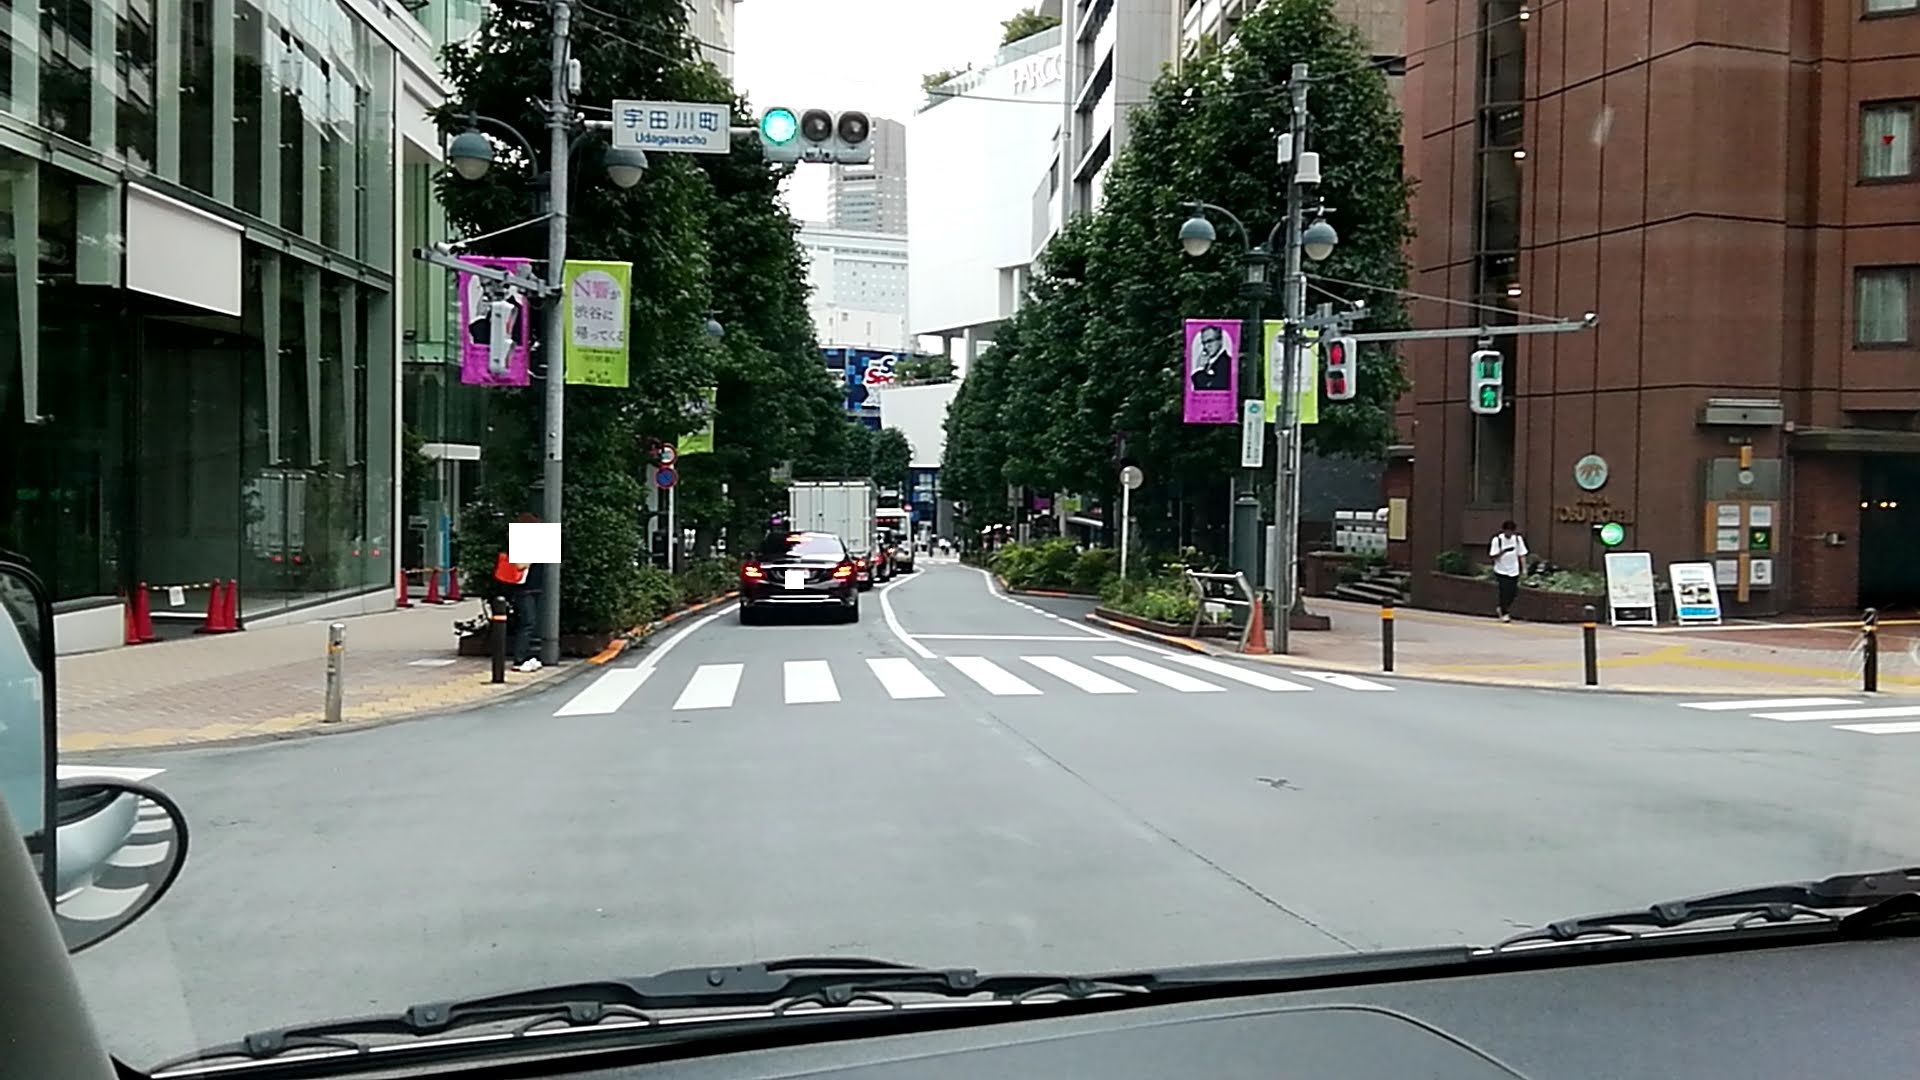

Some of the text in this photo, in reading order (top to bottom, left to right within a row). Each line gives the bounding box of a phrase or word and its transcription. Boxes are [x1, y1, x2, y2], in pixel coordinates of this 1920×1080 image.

[623, 108, 719, 132] 宇田川町
[635, 132, 707, 147] Udagawacho
[574, 305, 614, 321] 渋谷に
